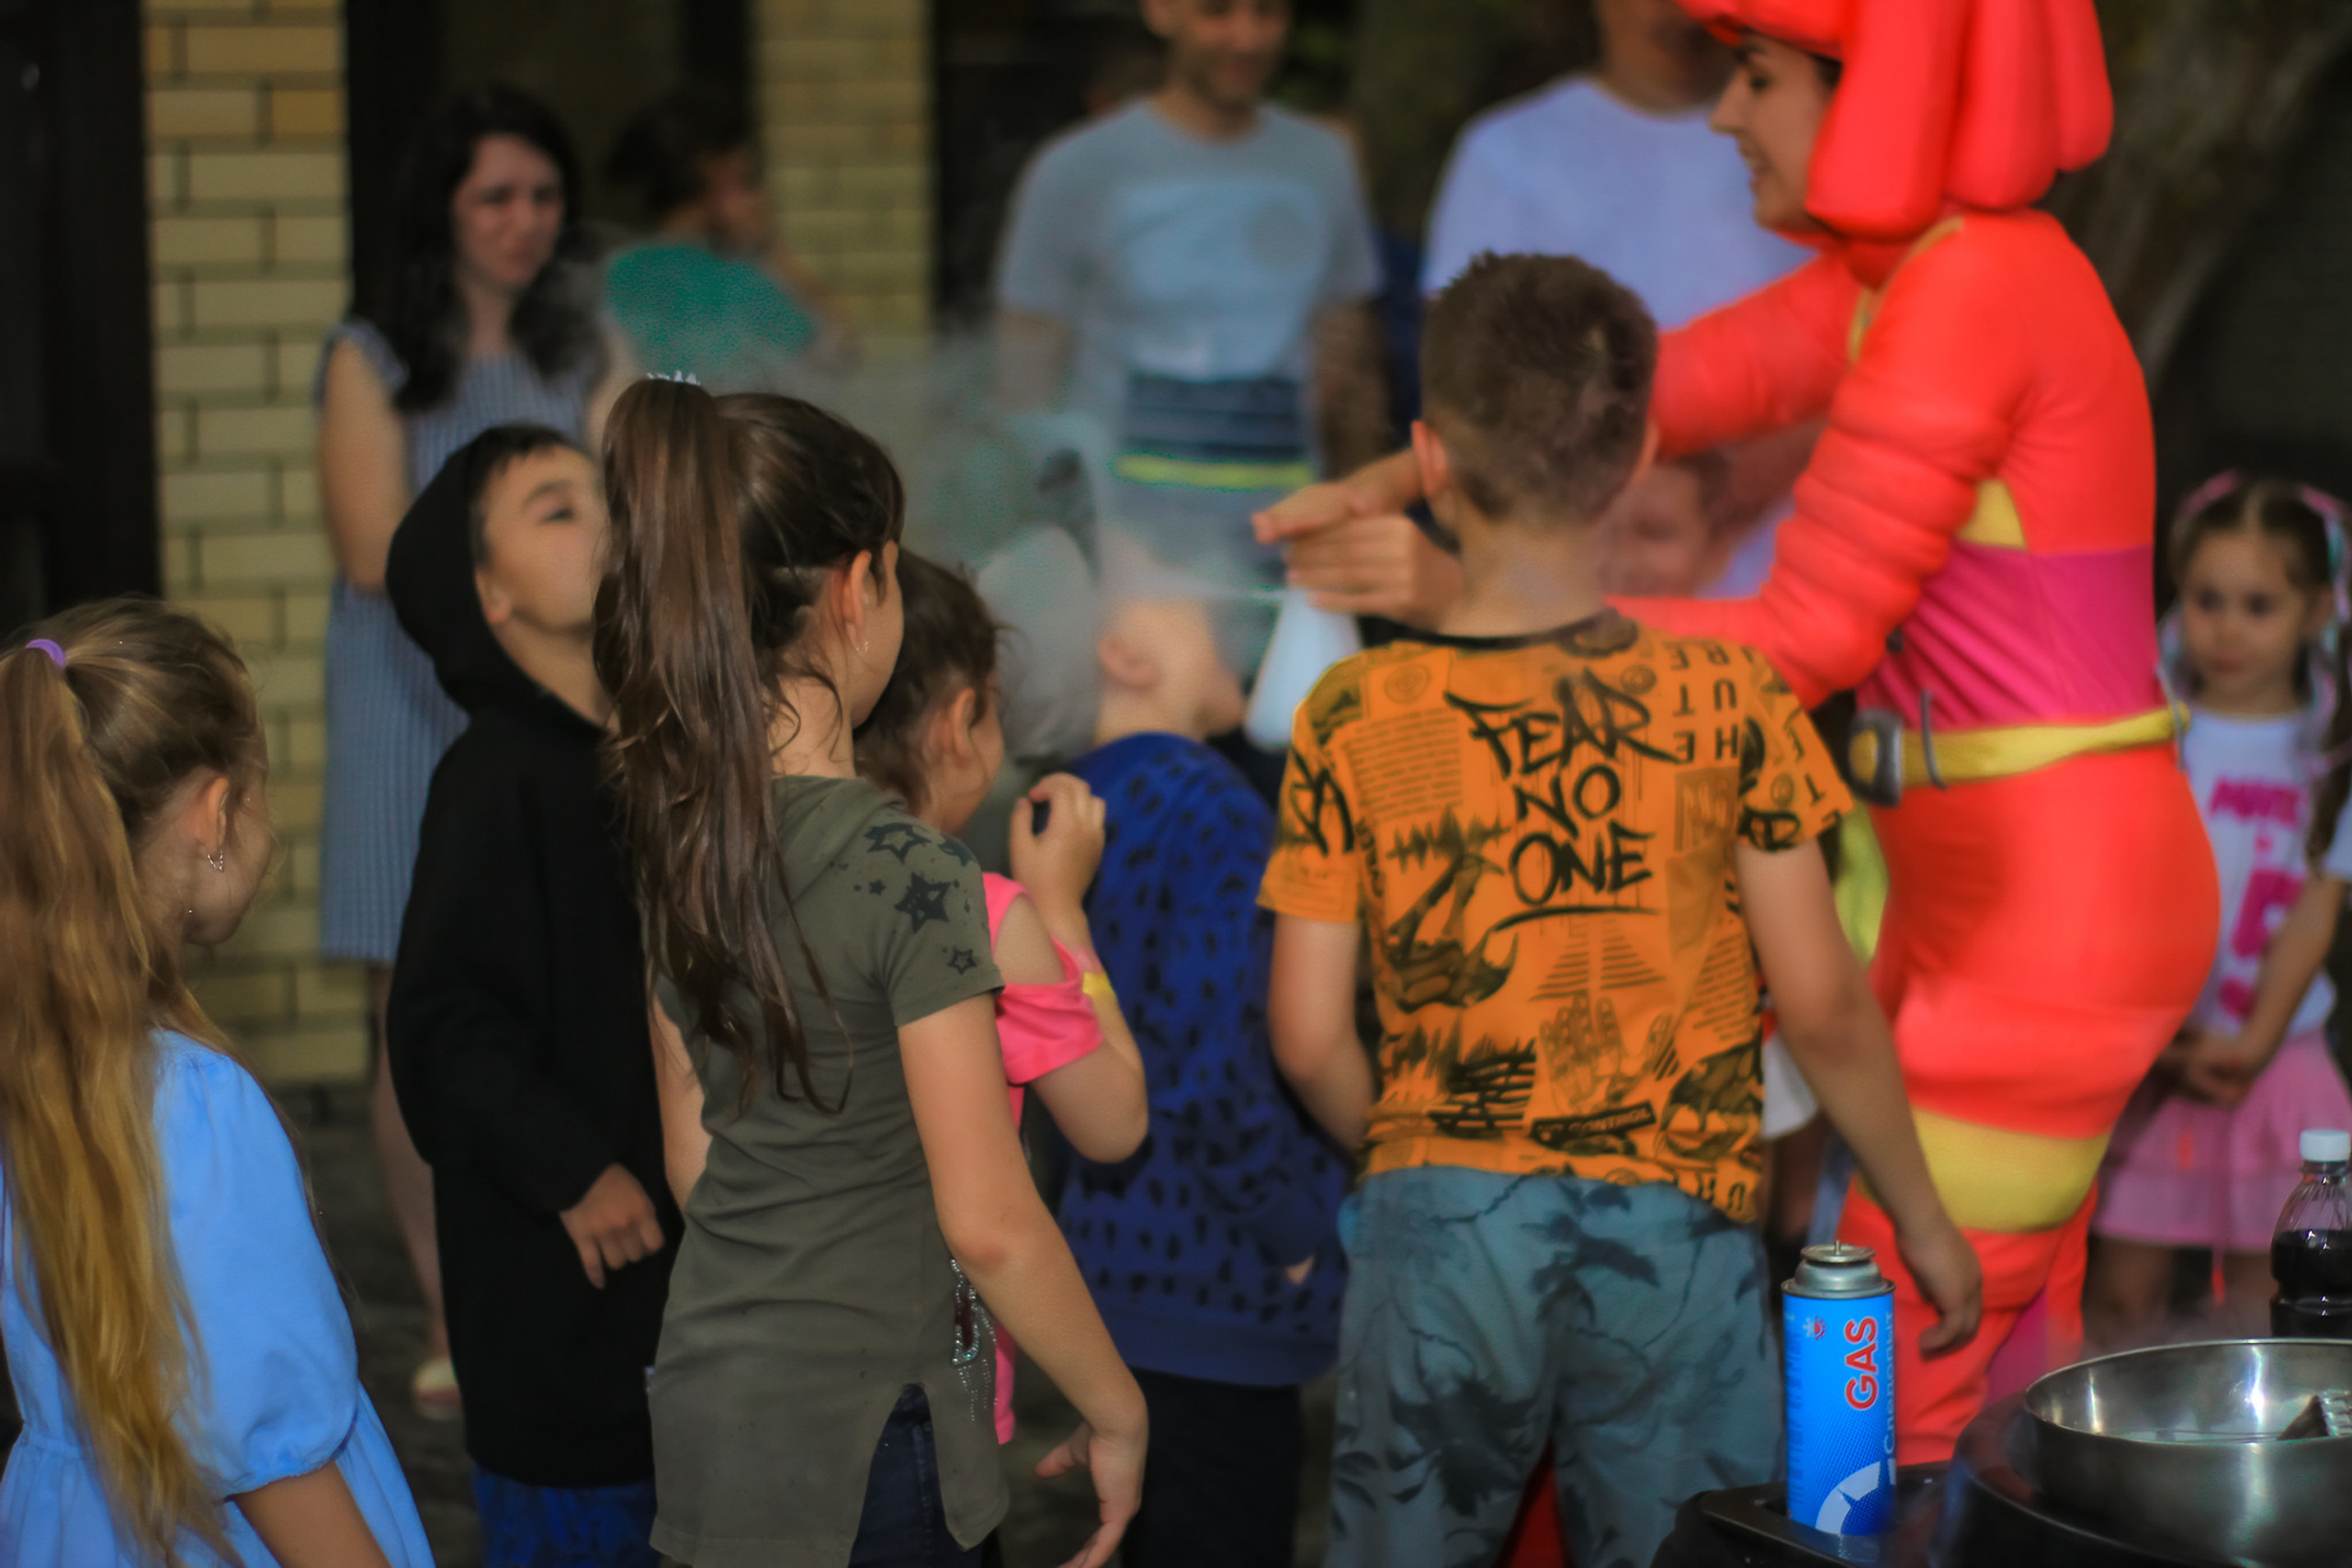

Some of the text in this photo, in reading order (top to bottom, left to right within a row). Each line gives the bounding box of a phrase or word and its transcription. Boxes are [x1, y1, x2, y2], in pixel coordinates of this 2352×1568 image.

[1443, 666, 1689, 780] FEAR
[1514, 764, 1622, 840] NO
[1510, 819, 1656, 907] ONE
[1844, 1316, 1878, 1410] GAS
